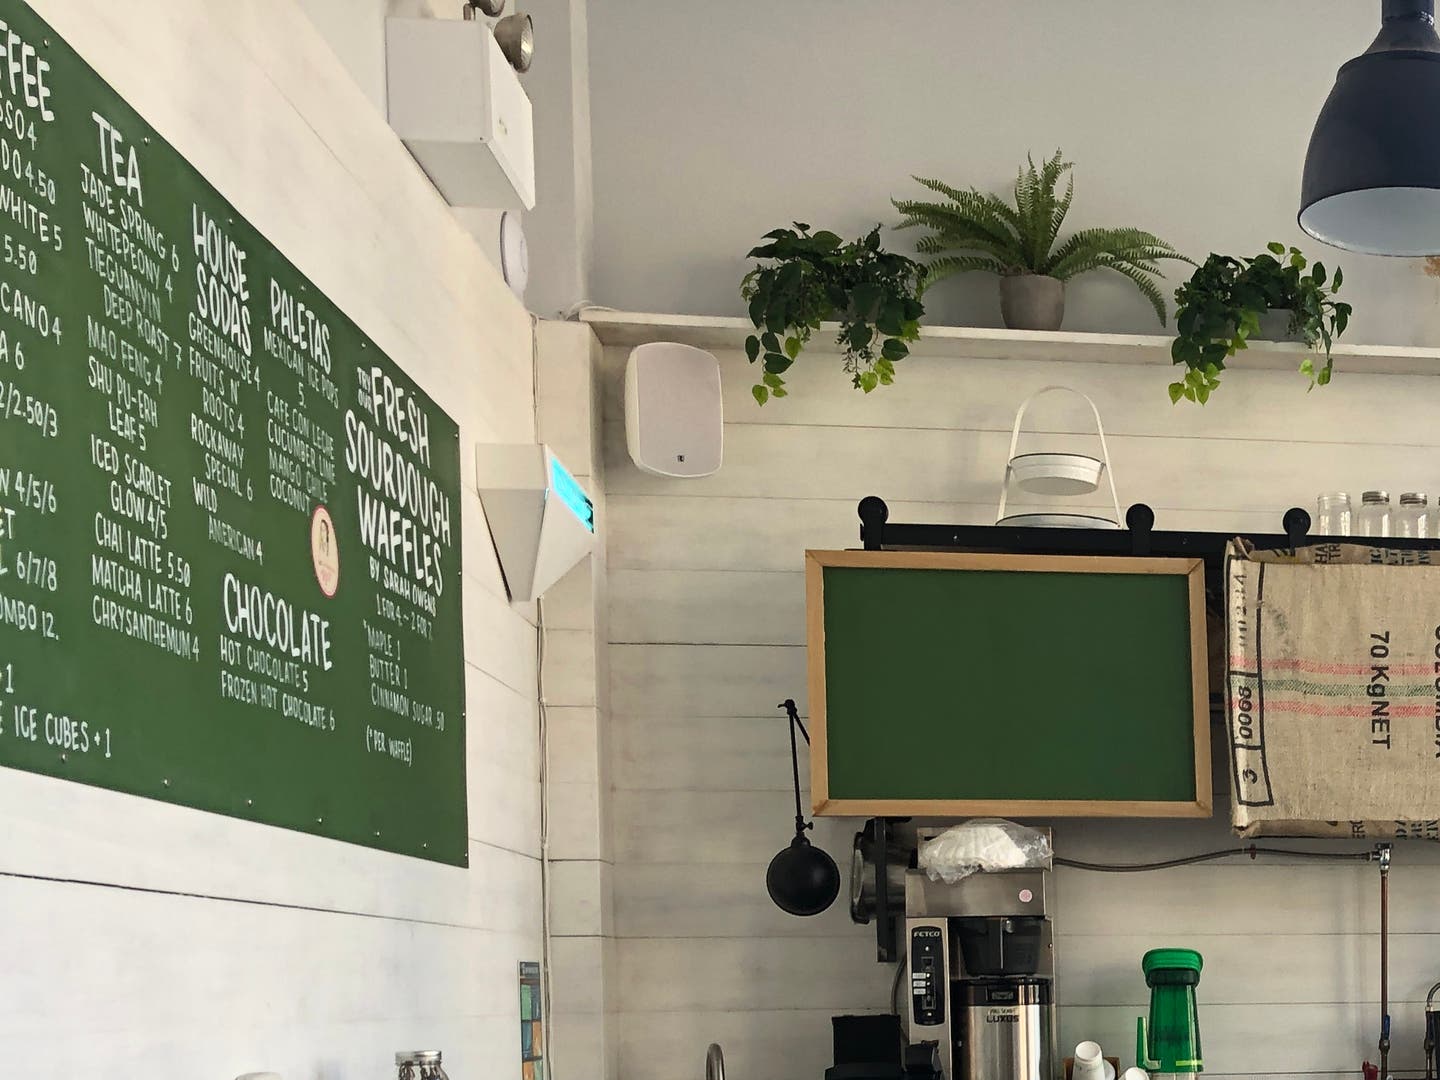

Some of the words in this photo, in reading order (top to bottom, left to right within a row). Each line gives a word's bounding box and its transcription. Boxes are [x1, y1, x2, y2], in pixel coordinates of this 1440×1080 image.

[25, 161, 56, 205] 4.50
[92, 111, 143, 208] TEA
[53, 225, 62, 251] 5
[80, 162, 115, 215] JADE
[120, 198, 166, 260] SPRING
[172, 244, 180, 272] 6
[4, 234, 37, 275] 5.50
[192, 203, 249, 302] HOUSE
[164, 274, 173, 303] 4
[196, 262, 252, 358] SODAS
[52, 317, 62, 345] 4
[104, 284, 133, 329] DEEP
[136, 309, 170, 362] ROAST
[269, 276, 332, 376] PALETAS
[15, 341, 24, 370] 6
[88, 315, 117, 361] MAO
[121, 339, 151, 387] FENG
[155, 364, 163, 395] 4
[188, 312, 252, 385] GREENHOUSE
[254, 366, 261, 392] 4
[189, 346, 225, 396] FRUITS
[264, 326, 304, 378] MEXICAN
[88, 355, 113, 394] SHU
[116, 373, 158, 428] PU-ERH
[203, 387, 235, 433] ROOTS
[237, 413, 245, 440] 4
[267, 390, 290, 427] CAFE
[371, 366, 431, 470] FRESH
[109, 401, 137, 444] LEAF
[139, 424, 147, 451] 5
[191, 412, 245, 470] ROCKAWAY
[15, 471, 57, 514] 4/5/6
[91, 434, 119, 475] ICED
[124, 453, 171, 509] SCARLET
[192, 476, 218, 513] WILD
[205, 453, 243, 497] SPECIAL
[246, 478, 254, 502] 6
[270, 473, 310, 517] COCONUT
[345, 408, 452, 548] SOURDOUGH
[110, 480, 145, 525] GLOW
[147, 501, 168, 540] 4/5
[95, 511, 123, 554] CHAI
[127, 530, 162, 574] LATTE
[168, 551, 191, 588] 5.50
[208, 514, 255, 561] AMERICAN
[256, 541, 264, 567] 4
[357, 485, 443, 597] WAFFLES
[16, 551, 57, 592] 6/7/8
[92, 554, 143, 603] MATCHA
[148, 579, 181, 620] LATTE
[185, 597, 193, 624] 6
[369, 555, 380, 582] BY
[383, 564, 411, 601] SARAH
[412, 583, 437, 618] OWENS
[93, 595, 191, 661] CHRYSANTHEMUM
[191, 635, 200, 662] 4
[223, 572, 333, 672] CHOCOLATE
[1370, 630, 1390, 660] 70
[220, 634, 242, 666] HOT
[246, 645, 301, 688] CHOCOLATE
[302, 670, 309, 693] 5
[369, 654, 401, 687] BUTTER
[14, 705, 38, 741] ICE
[45, 713, 89, 752] CUBES
[221, 670, 258, 706] FROZEN
[261, 682, 278, 710] HOT
[282, 692, 327, 730] CHOCOLATE
[329, 708, 336, 732] 6
[1237, 685, 1253, 740] 0068
[1242, 767, 1258, 785] 3
